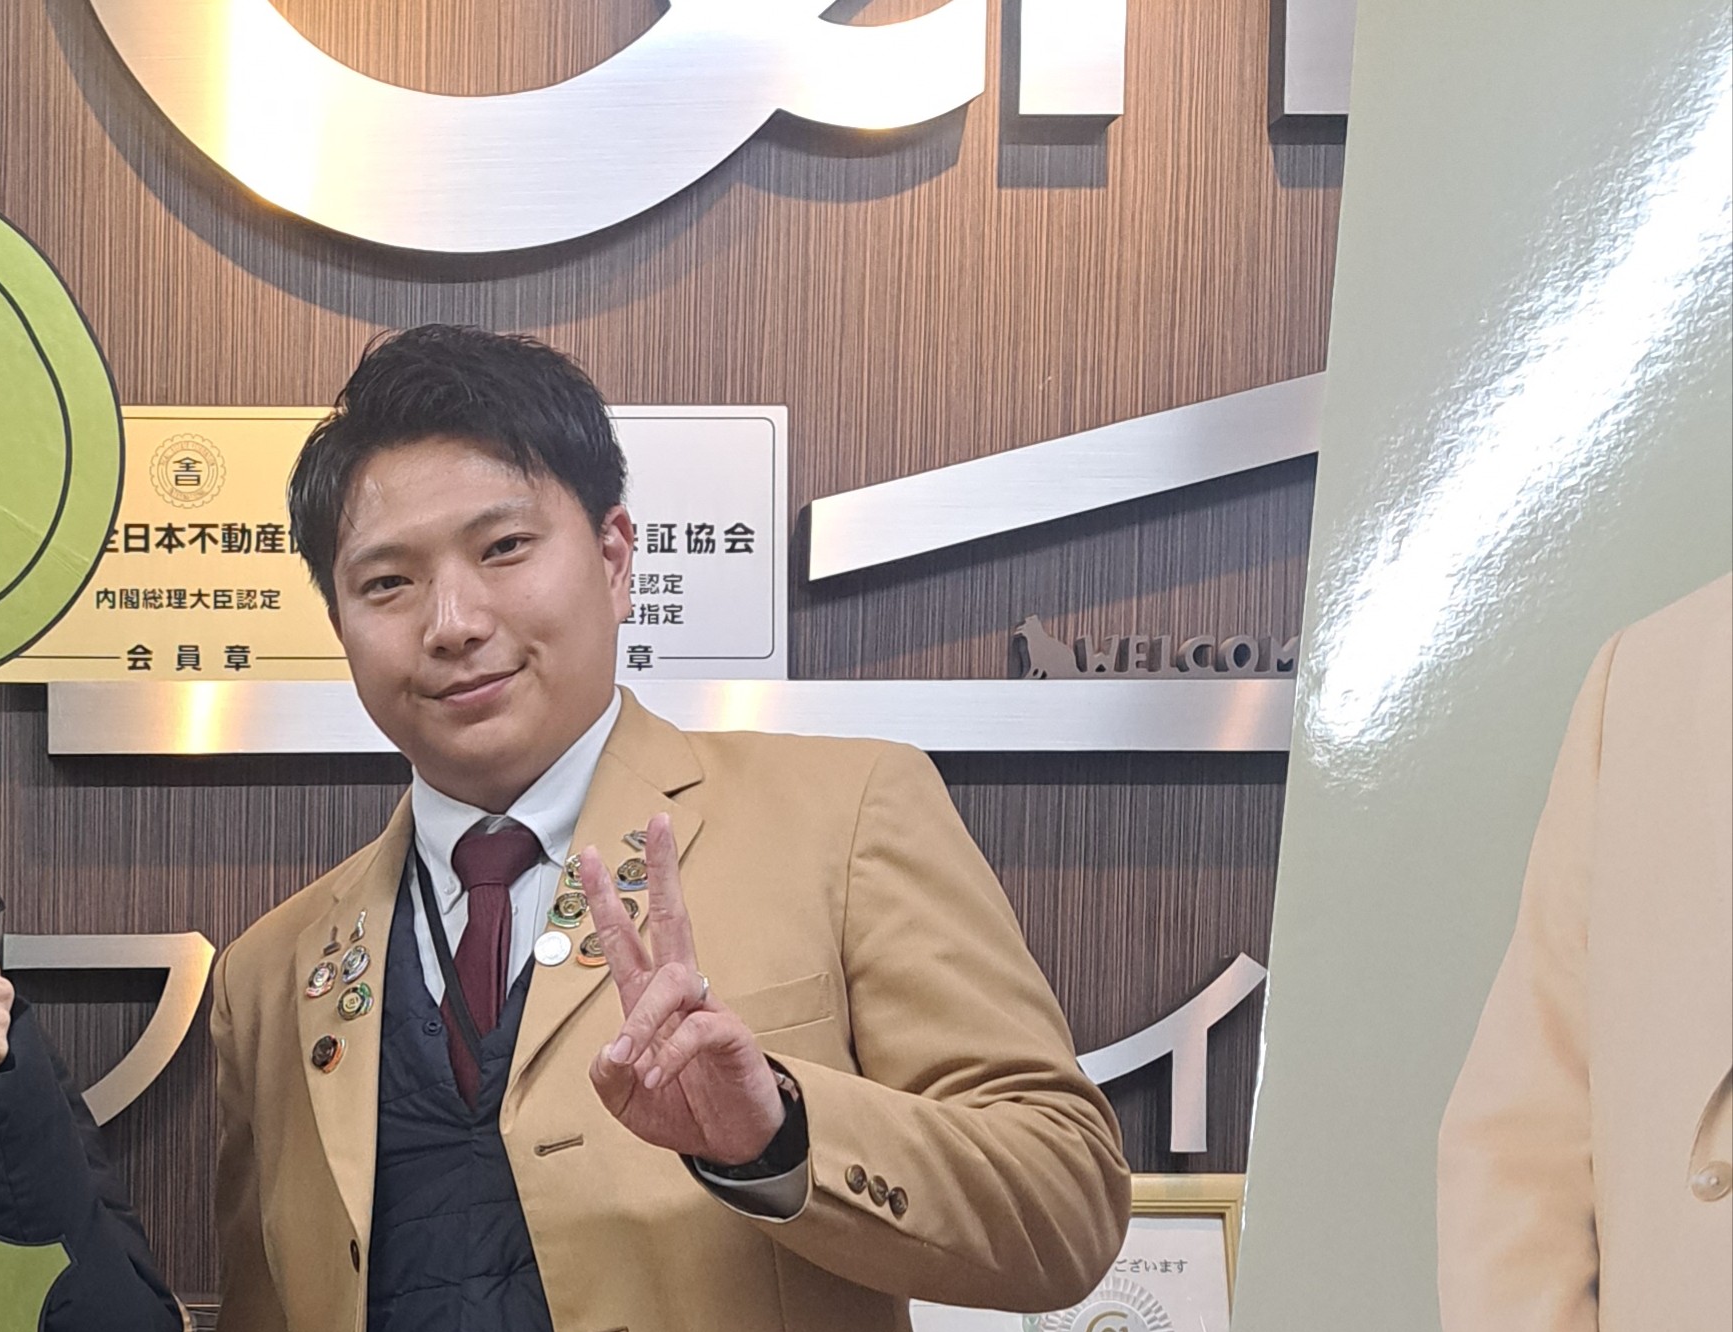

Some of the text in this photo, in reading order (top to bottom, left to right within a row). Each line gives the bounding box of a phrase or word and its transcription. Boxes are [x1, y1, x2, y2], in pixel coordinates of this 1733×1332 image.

[103, 522, 300, 554] 日本不動産
[95, 588, 281, 610] 内閣総理大臣認定
[126, 644, 252, 671] 会員章
[626, 644, 654, 672] 章
[1114, 1258, 1188, 1274] ございます
